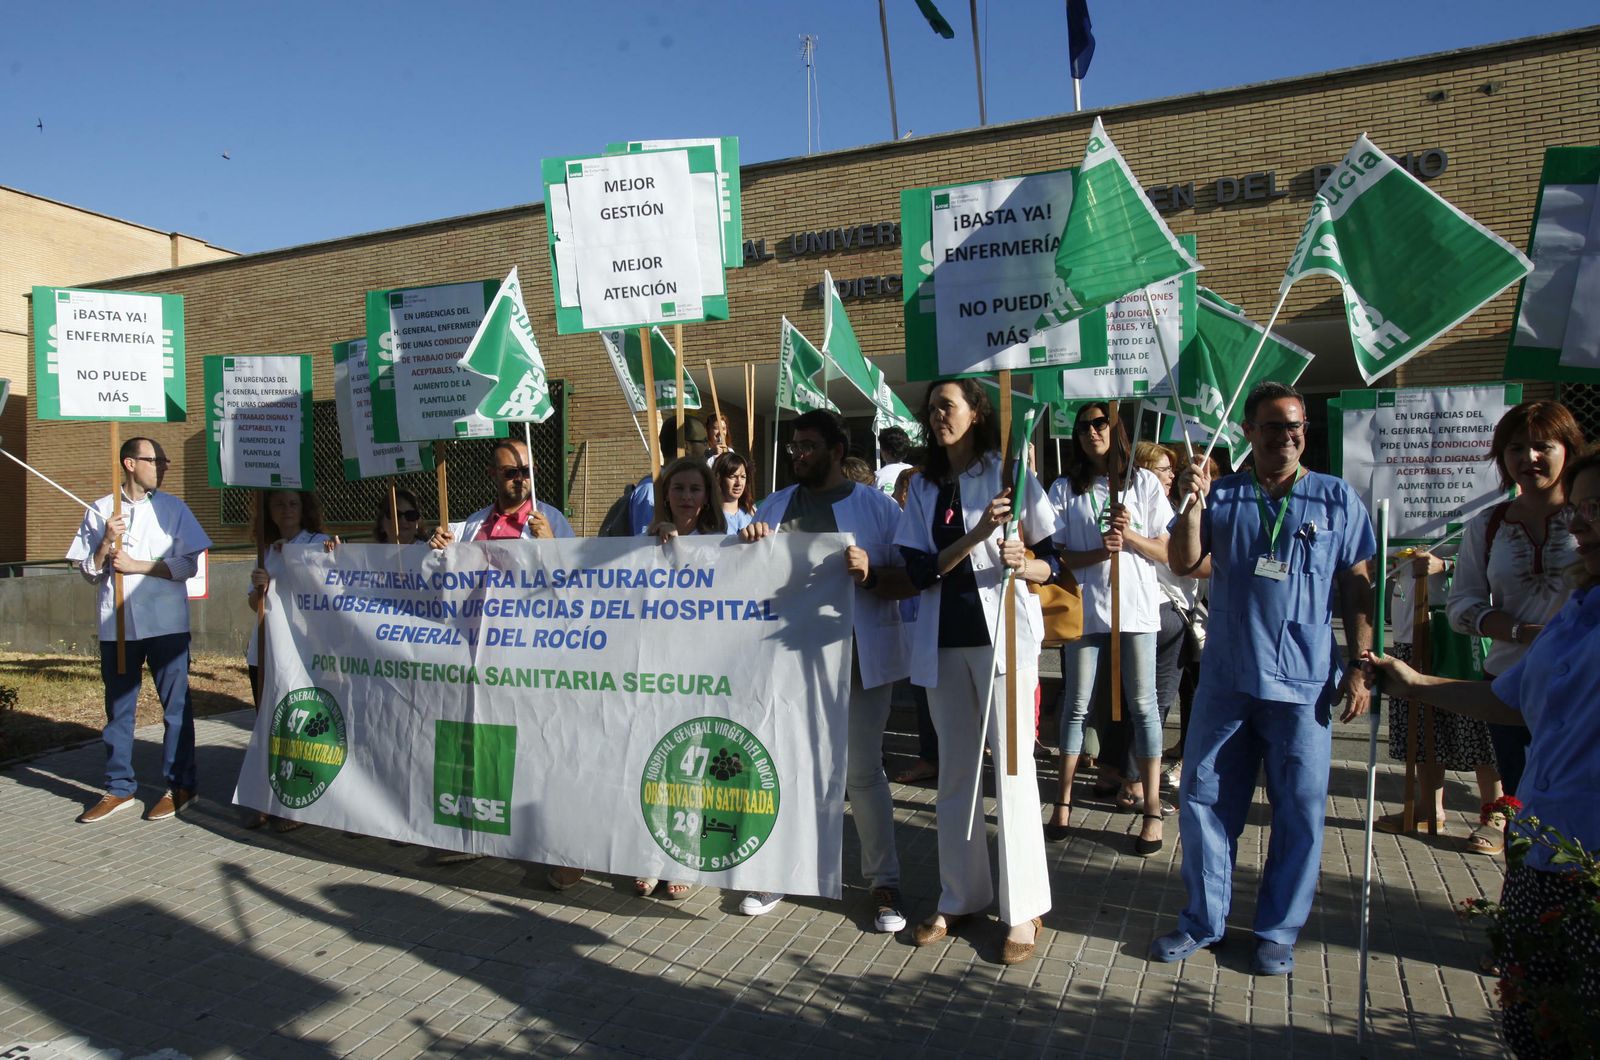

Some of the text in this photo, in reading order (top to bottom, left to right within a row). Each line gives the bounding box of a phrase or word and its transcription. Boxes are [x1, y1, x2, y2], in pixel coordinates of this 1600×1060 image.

[604, 177, 655, 193] MEJOR
[600, 201, 664, 220] GESTIÓN
[792, 222, 900, 255] UNIVER
[1217, 170, 1288, 203] DEL
[953, 204, 1052, 231] ¡BASTA YA!
[945, 233, 1060, 263] ENFERMERÍA
[612, 256, 663, 272] MEJOR
[604, 280, 677, 301] ATENCIÓN
[73, 309, 147, 323] ¡BASTA YA!
[415, 309, 455, 319] URGENCIAS
[959, 301, 987, 318] NO
[402, 325, 436, 335] GENERAL,
[1107, 323, 1138, 331] TABLES,
[66, 330, 155, 344] ENFERMERÍA
[396, 336, 474, 350] PIDE UNAS CONDICION
[987, 326, 1029, 347] MÁS
[402, 351, 465, 364] DE TRABAJO DIGN
[77, 370, 147, 381] NO PUEDE
[412, 367, 454, 376] ACEPTABLES,
[1094, 366, 1148, 376] ENFERMERÍA
[413, 381, 449, 390] AUMENTO
[462, 379, 471, 387] LA
[98, 390, 129, 402] MÁS
[420, 395, 455, 404] PLANTILLA
[422, 409, 466, 418] ENFERMERÍA
[1395, 410, 1483, 421] EN URGENCIAS DEL
[1391, 426, 1435, 435] GENERAL,
[1381, 440, 1492, 450] PIDE UNAS CONDICIONE
[1386, 456, 1398, 464] DE
[1401, 455, 1442, 464] TRABAJO
[1444, 454, 1480, 463] DIGNAS
[1396, 468, 1454, 476] ACEPTABLES,
[1458, 467, 1463, 475] Y
[1397, 482, 1445, 490] AUMENTO
[1403, 495, 1465, 504] PLANTILLA DE
[1404, 509, 1463, 518] ENFERMERÍA
[431, 569, 515, 590] CONTRA
[521, 570, 547, 588] LA
[552, 564, 714, 589] SATURACIÓN
[297, 594, 778, 621] DE LA OBSERVACIÓN URGENCIAS DEL HOSPITAL
[376, 623, 462, 646] GENERAL
[486, 627, 527, 647] DEL
[532, 625, 607, 650] ROCÍO
[312, 654, 732, 697] POR UNA ASISTENCIA SANITARIA SEGURA
[287, 708, 310, 734] 47
[304, 741, 345, 766] SATURADA
[646, 738, 676, 781] HOSPITAL
[673, 720, 712, 743] GENERAL
[714, 721, 747, 745] VIRGEN
[743, 740, 761, 761] DEL
[680, 745, 710, 778] 47
[282, 793, 293, 805] TU
[295, 781, 326, 806] SALUD
[644, 779, 775, 815] OBSERVACIÓN SATURADA
[438, 792, 505, 824] SATSE
[673, 811, 699, 837] 29
[655, 828, 760, 869] POR TU SALUD
